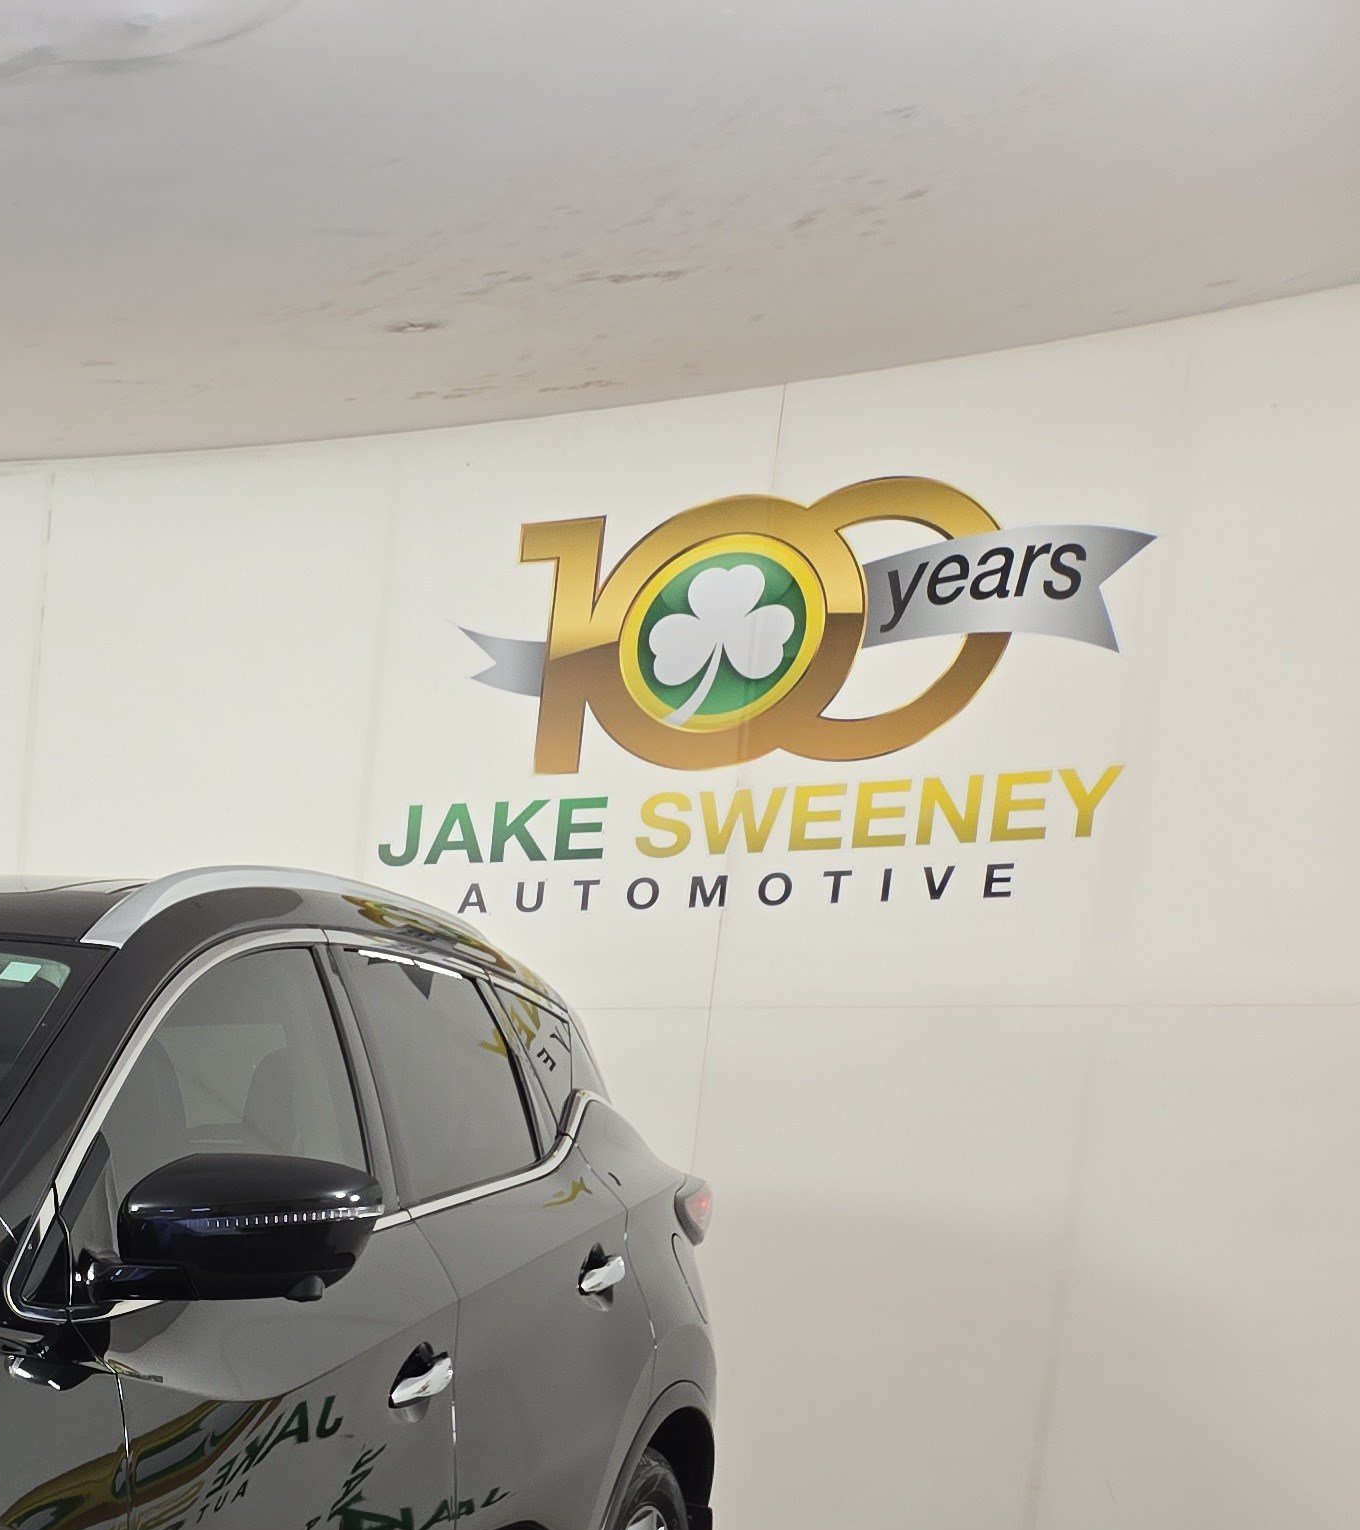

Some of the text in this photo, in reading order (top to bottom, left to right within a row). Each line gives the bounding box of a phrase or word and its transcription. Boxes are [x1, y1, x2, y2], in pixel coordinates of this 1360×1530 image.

[881, 543, 1087, 631] years
[378, 764, 1125, 866] JAKE SWEENEY
[457, 863, 1015, 914] AUTOMOTIVE
